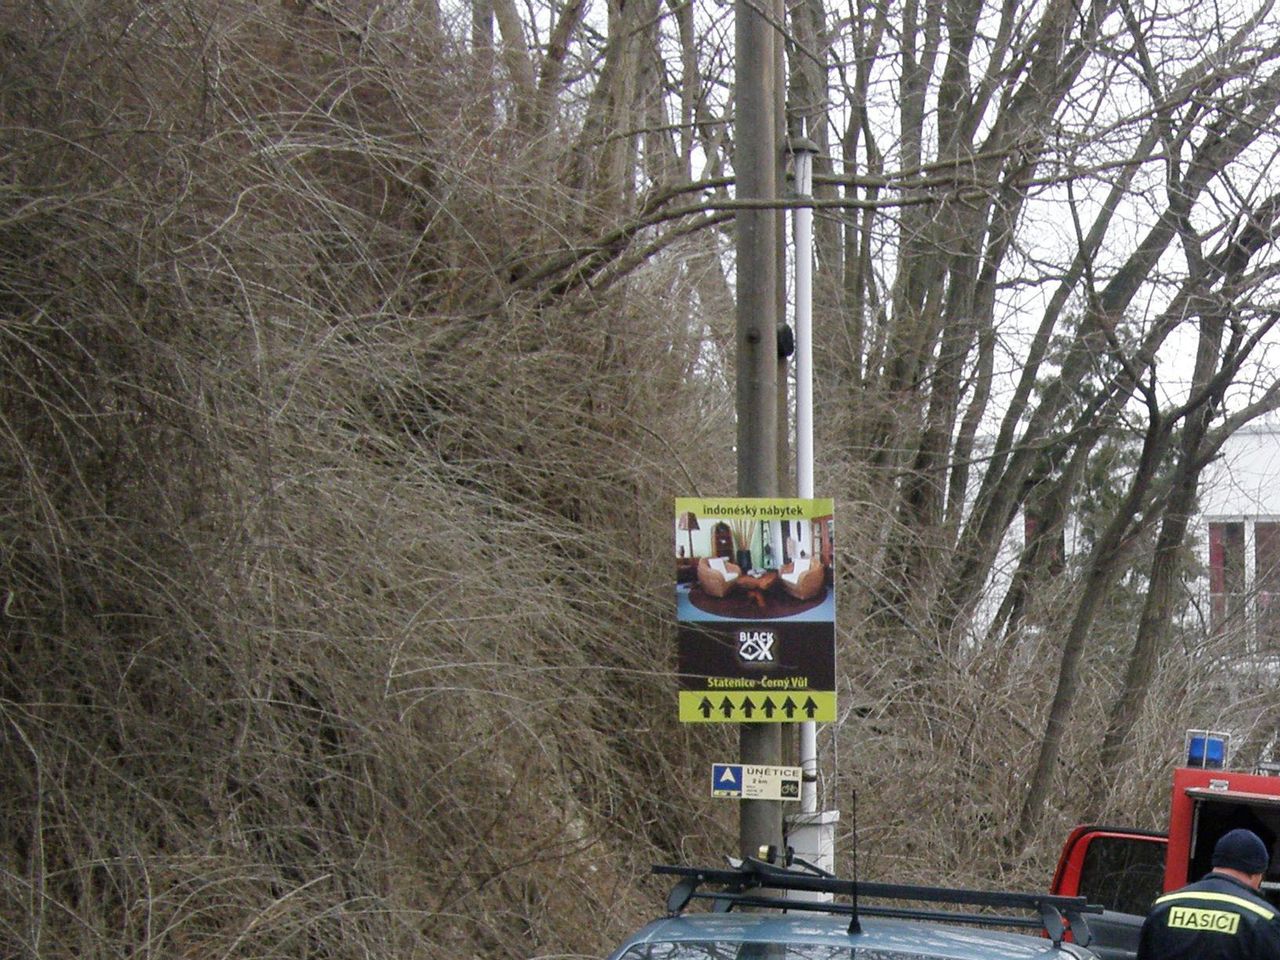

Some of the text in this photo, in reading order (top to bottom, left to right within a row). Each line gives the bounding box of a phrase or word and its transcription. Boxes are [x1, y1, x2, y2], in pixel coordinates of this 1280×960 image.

[702, 504, 804, 518] indonéský nábytek
[739, 631, 774, 641] BLACK
[707, 676, 755, 688] Statenice
[761, 675, 790, 689] Černý
[791, 676, 808, 688] Vůl
